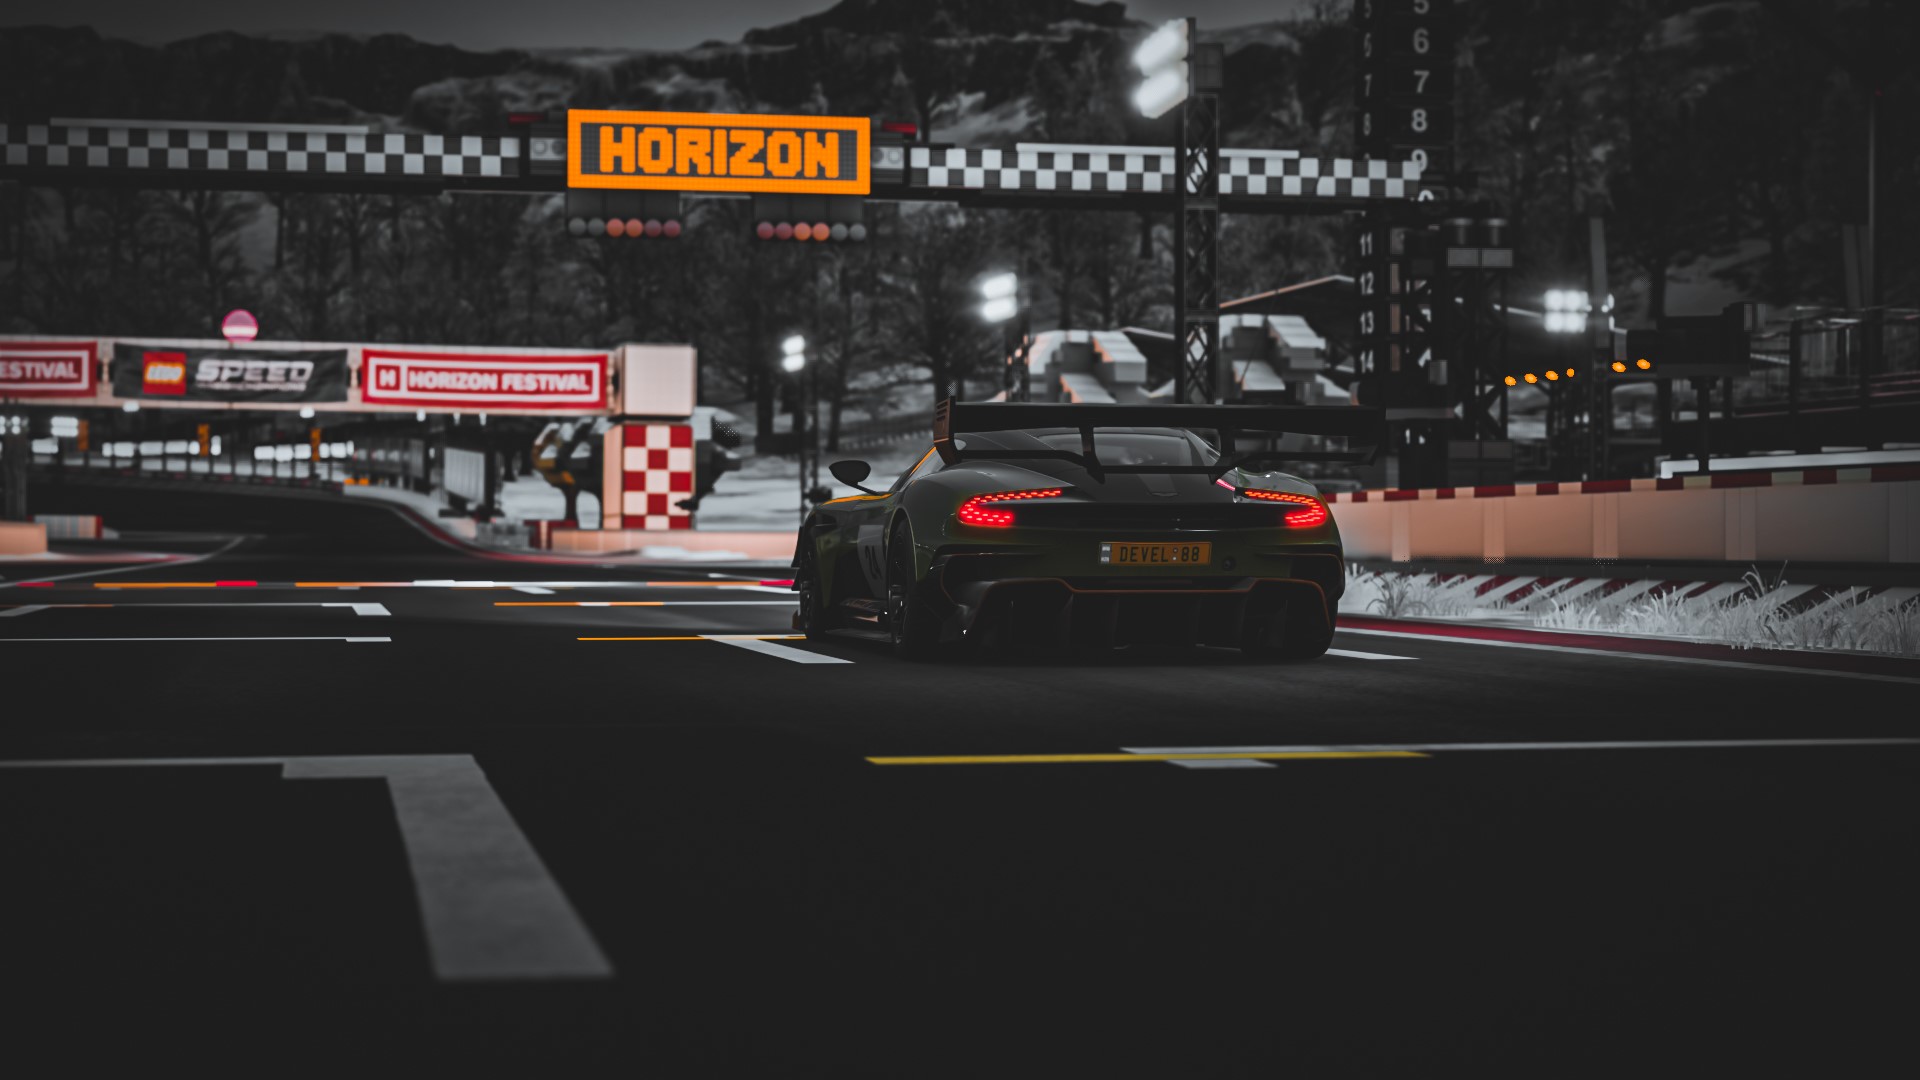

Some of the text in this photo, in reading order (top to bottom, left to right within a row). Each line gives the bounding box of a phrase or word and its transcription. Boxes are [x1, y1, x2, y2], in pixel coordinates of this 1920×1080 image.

[1413, 27, 1430, 54] 6
[1413, 69, 1430, 94] 7
[1411, 108, 1428, 133] 8
[599, 125, 839, 178] HORIZON
[1359, 232, 1373, 257] 11
[1359, 271, 1375, 295] 12
[1359, 310, 1375, 335] 13
[195, 359, 315, 382] SPEED
[1359, 349, 1375, 374] 14
[379, 369, 396, 387] H
[408, 366, 590, 391] HORIZON FESTIVAL
[1119, 546, 1200, 562] DEVEL 88
